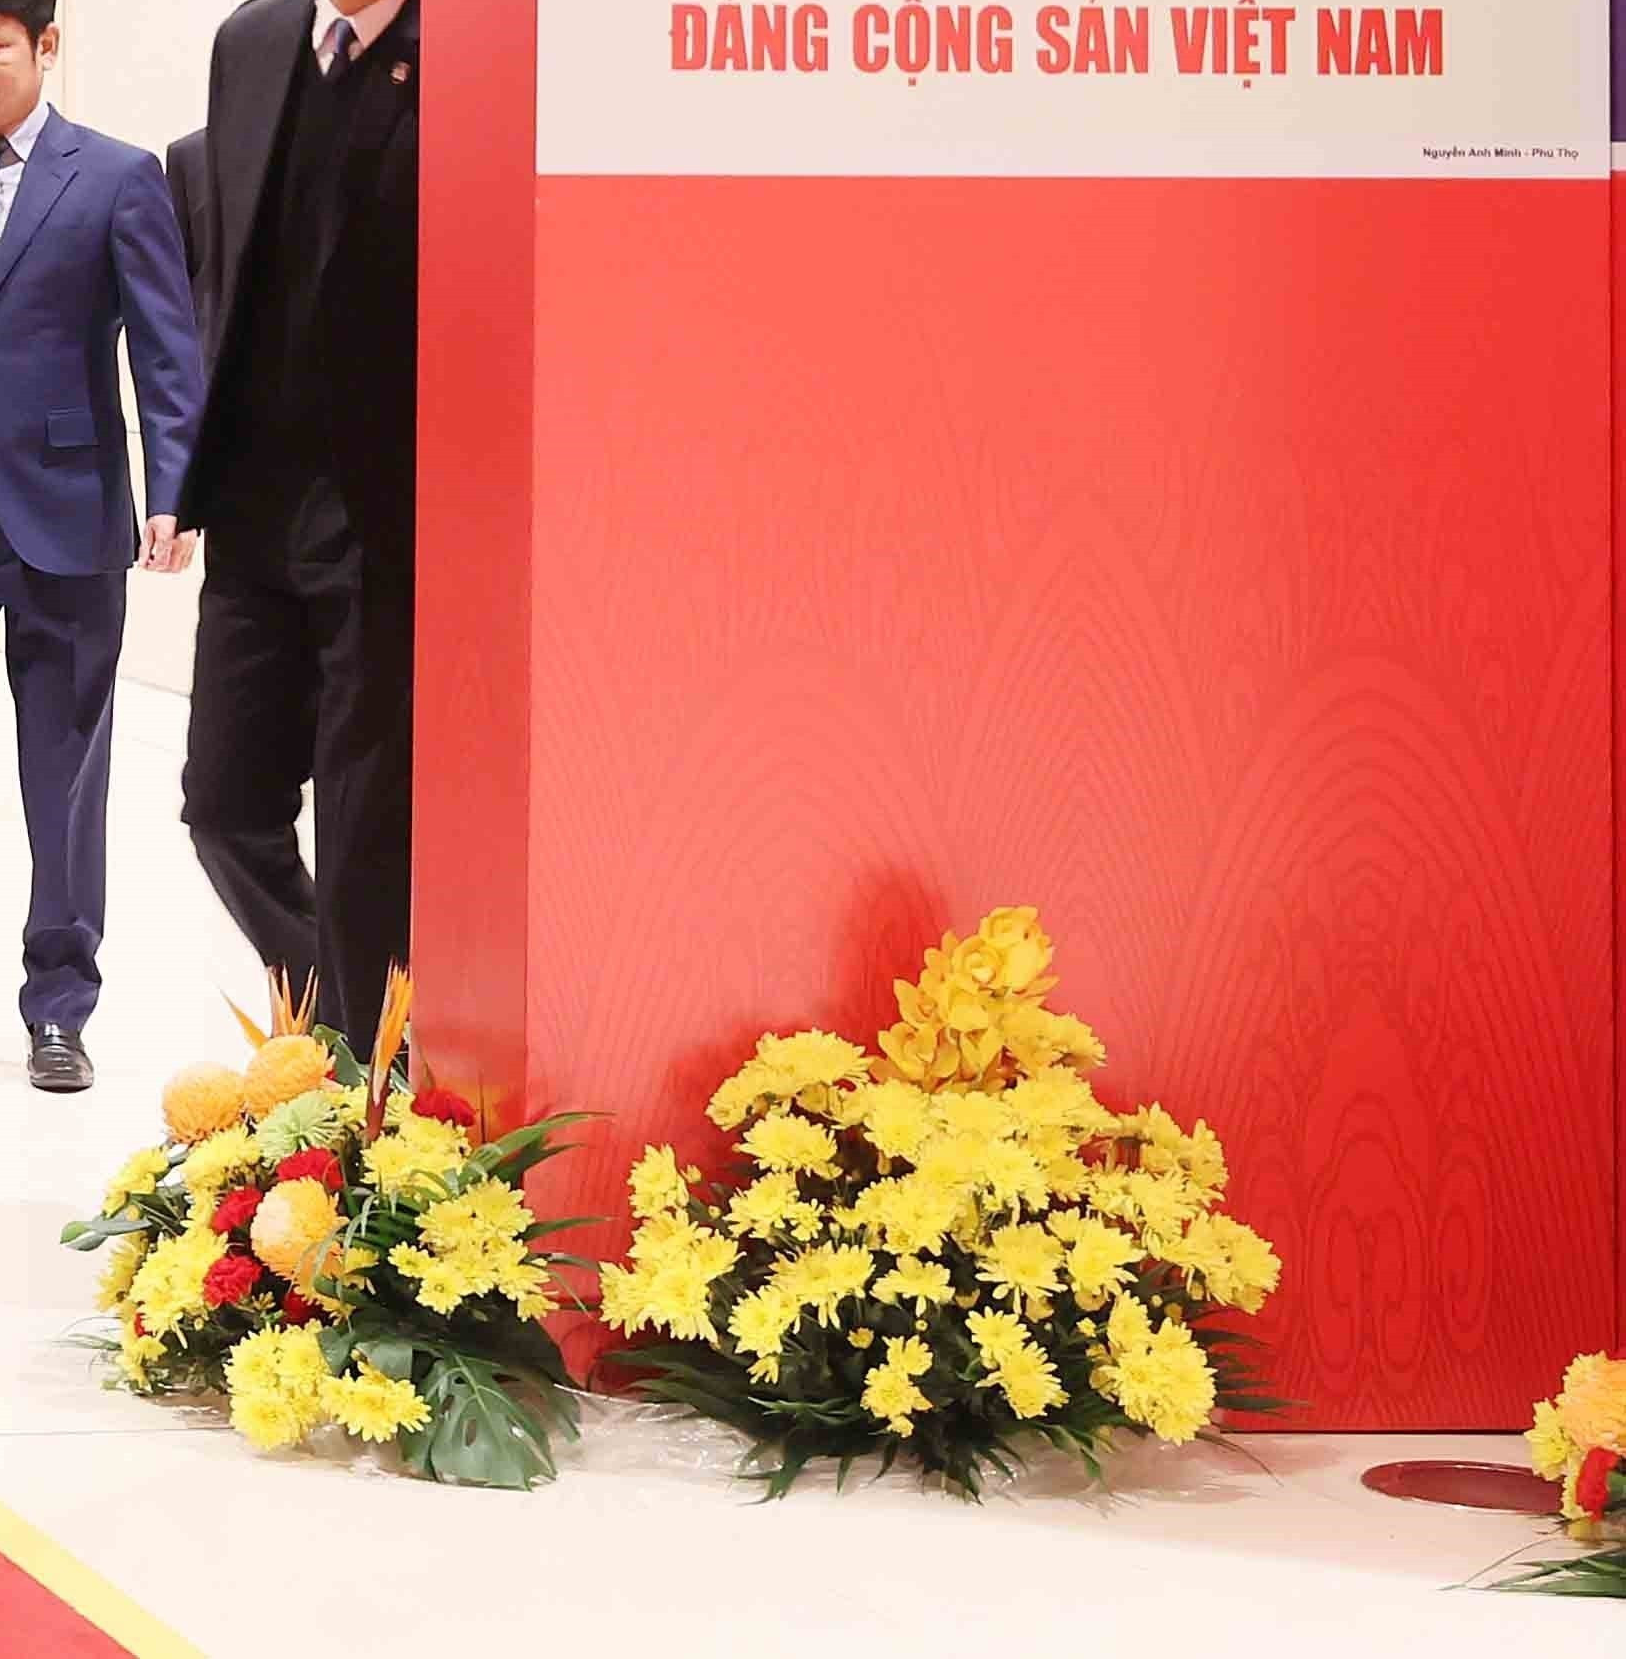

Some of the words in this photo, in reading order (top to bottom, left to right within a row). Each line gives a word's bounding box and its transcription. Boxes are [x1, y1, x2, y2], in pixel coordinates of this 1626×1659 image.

[1315, 6, 1444, 78] NAM
[1422, 145, 1466, 160] Nguyễn
[1468, 147, 1492, 158] Anh
[1494, 147, 1522, 158] Minh
